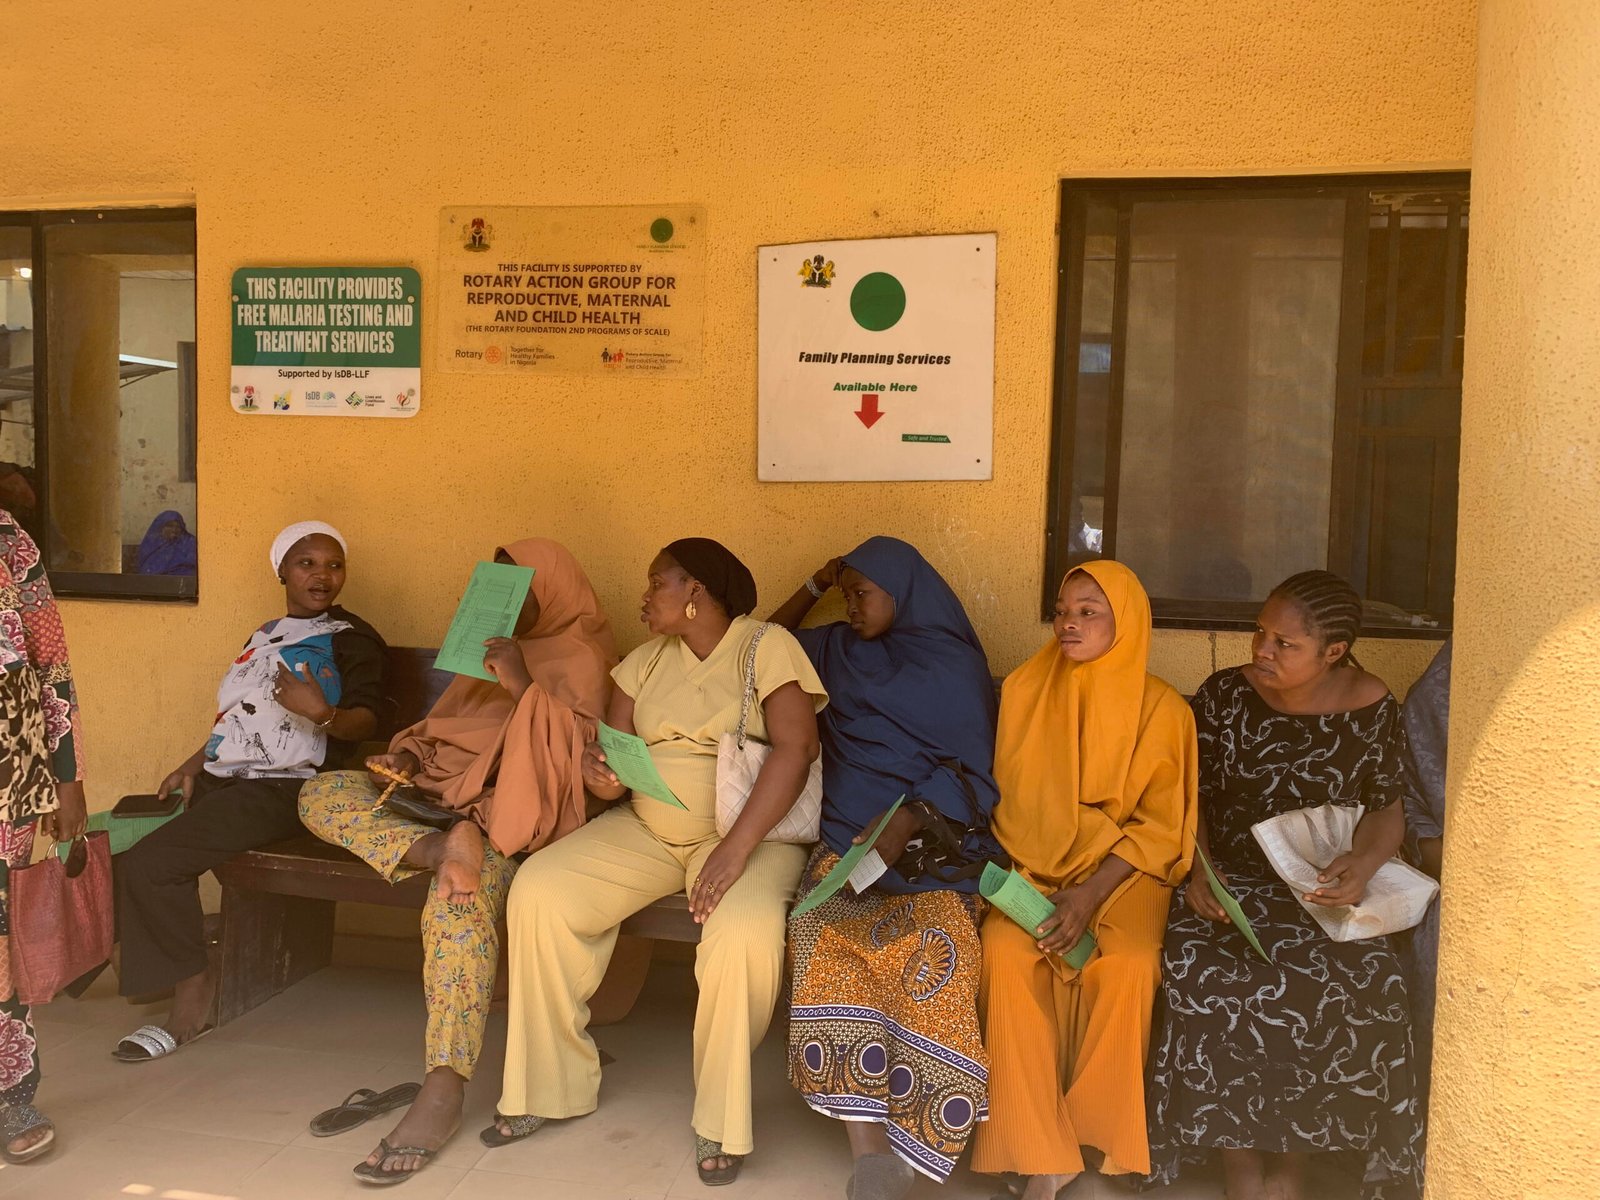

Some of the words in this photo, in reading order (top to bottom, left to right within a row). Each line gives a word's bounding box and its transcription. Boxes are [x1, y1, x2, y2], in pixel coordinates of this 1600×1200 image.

[498, 264, 518, 272] THIS
[521, 264, 560, 272] FACILITY
[562, 264, 570, 272] IS
[573, 264, 627, 273] SUPPORTED
[630, 264, 642, 273] BY
[246, 277, 276, 300] THIS
[279, 277, 335, 300] FACILITY
[338, 277, 403, 300] PROVIDES
[463, 275, 522, 288] ROTARY
[526, 275, 583, 289] ACTION
[588, 276, 642, 289] GROUP
[646, 276, 676, 290] FOR
[467, 292, 582, 308] REPRODUCTIVE,
[587, 293, 671, 307] MATERNAL
[237, 304, 266, 326] FREE
[269, 304, 326, 326] MALARIA
[328, 304, 383, 327] TESTING
[385, 305, 413, 327] AND
[494, 310, 528, 323] AND
[532, 310, 577, 323] CHILD
[582, 311, 641, 325] HEALTH
[465, 325, 482, 333] (THE
[484, 325, 515, 333] ROTARY
[516, 326, 567, 334] FOUNDATION
[568, 326, 585, 334] 2ND
[587, 327, 631, 335] PROGRAMS
[644, 328, 671, 336] SCALE)
[255, 331, 328, 353] TREATMENT
[331, 331, 394, 354] SERVICES
[455, 349, 483, 360] Rotary
[510, 346, 535, 354] Together
[798, 352, 838, 364] Family
[840, 352, 894, 365] Planning
[897, 353, 951, 365] Services
[278, 369, 320, 379] Supported
[322, 370, 332, 380] by
[334, 370, 370, 379] IsDB-LLF
[833, 382, 886, 392] Available
[889, 382, 918, 392] Here
[305, 391, 320, 400] IsDB
